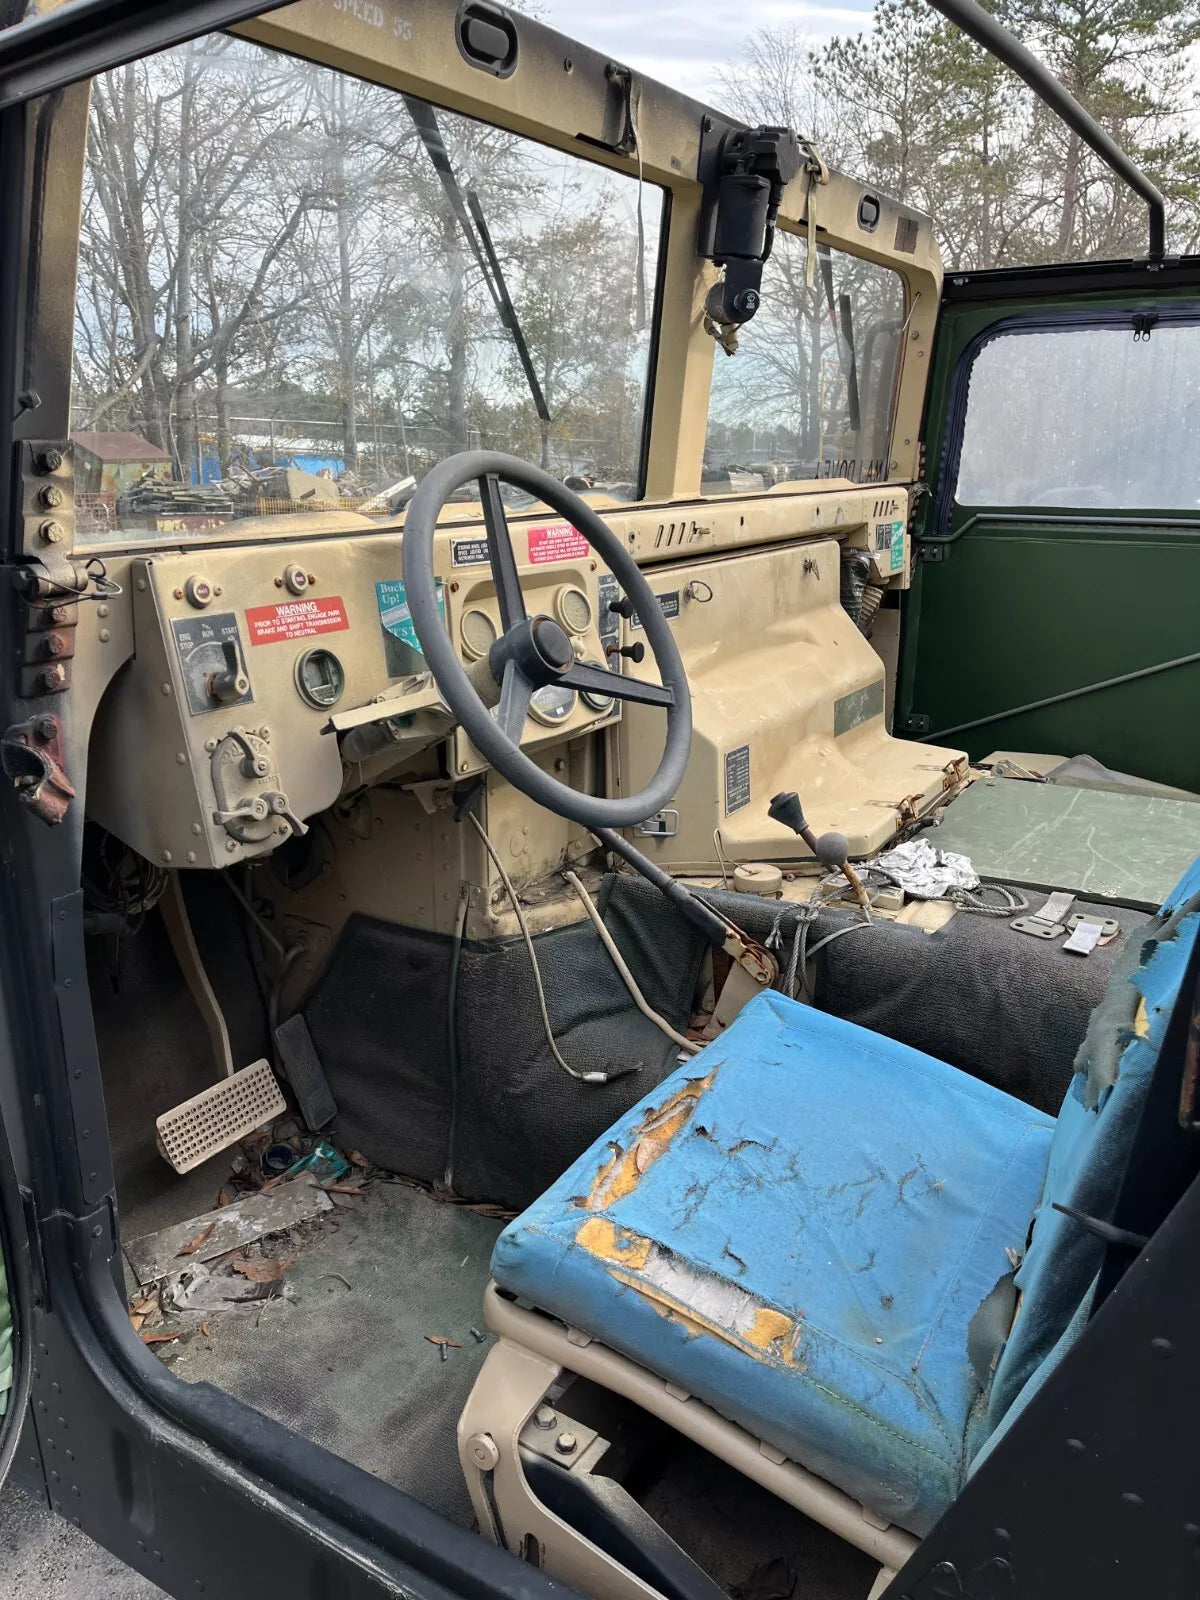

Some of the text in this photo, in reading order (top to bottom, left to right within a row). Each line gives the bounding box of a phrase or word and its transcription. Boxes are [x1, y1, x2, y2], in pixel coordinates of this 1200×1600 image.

[546, 527, 574, 538] WARNING
[382, 593, 400, 605] Up!
[275, 601, 318, 616] WARNING
[254, 620, 271, 629] PRIOR
[272, 618, 281, 626] TO
[307, 611, 327, 620] ENGAGE
[327, 609, 341, 617] PARK
[220, 626, 238, 635] START
[257, 617, 342, 636] BRAKE AND SHIFT TRANSMISSION
[178, 632, 192, 641] ENG
[201, 629, 215, 638] RUN
[285, 628, 318, 639] TO NEUTRAL
[179, 641, 194, 651] STOP
